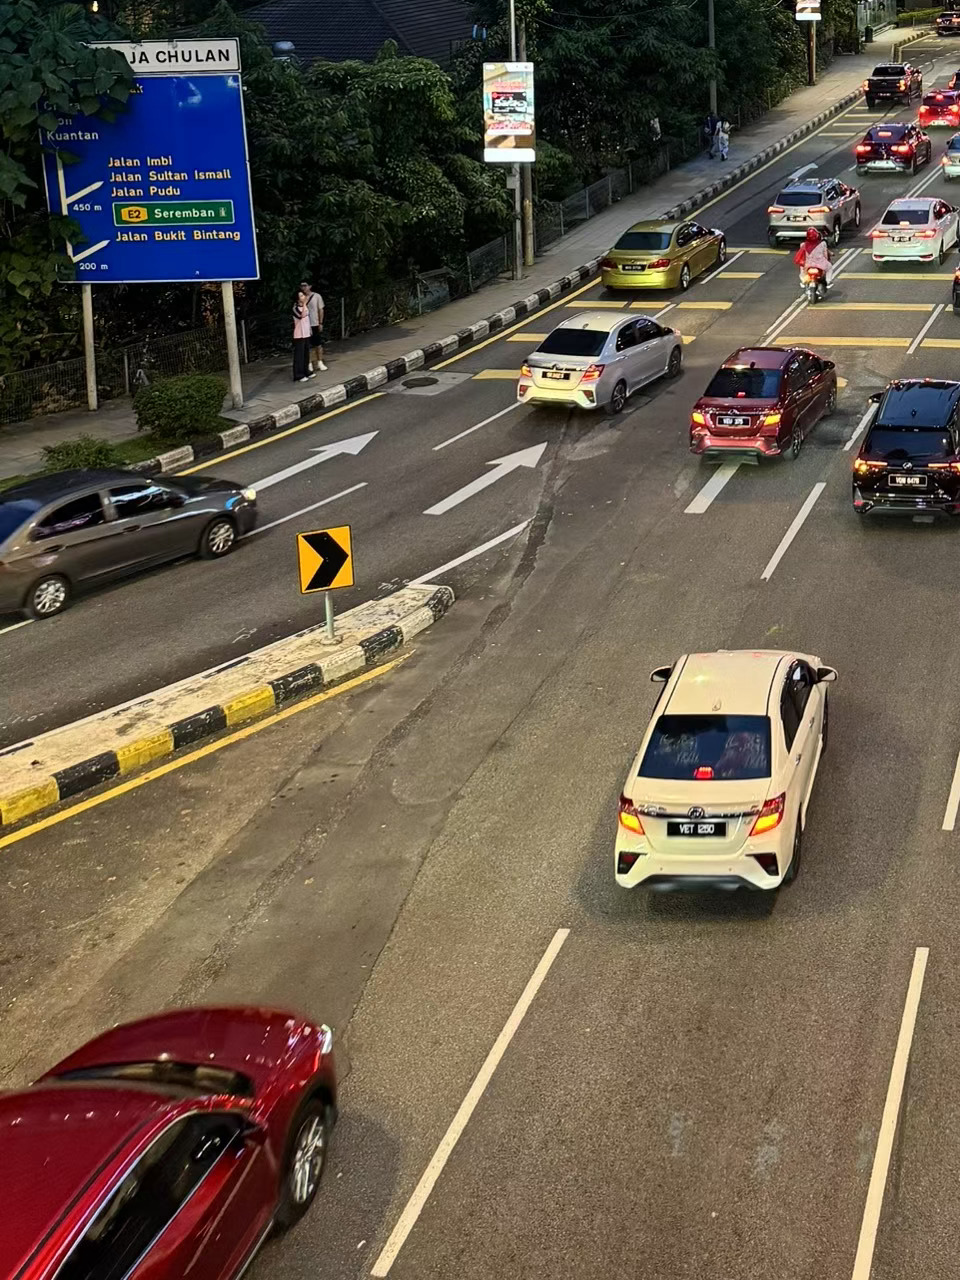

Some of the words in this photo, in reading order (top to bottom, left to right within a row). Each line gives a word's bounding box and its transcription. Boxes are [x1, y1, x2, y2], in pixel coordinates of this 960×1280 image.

[155, 49, 230, 64] CHULAN
[46, 130, 99, 140] Kuantan
[108, 157, 140, 167] Jalan
[147, 155, 172, 166] Imbi
[110, 172, 142, 182] Jalan
[149, 171, 188, 181] Sultan
[194, 169, 231, 180] Ismail
[112, 187, 143, 197] Jalan
[150, 186, 181, 196] Pudu
[127, 209, 141, 218] E2
[154, 208, 215, 218] Seremban
[116, 232, 148, 242] Jalan
[154, 230, 186, 240] Bukit
[193, 230, 241, 241] Bintang
[79, 262, 96, 270] 200
[679, 824, 695, 834] VET
